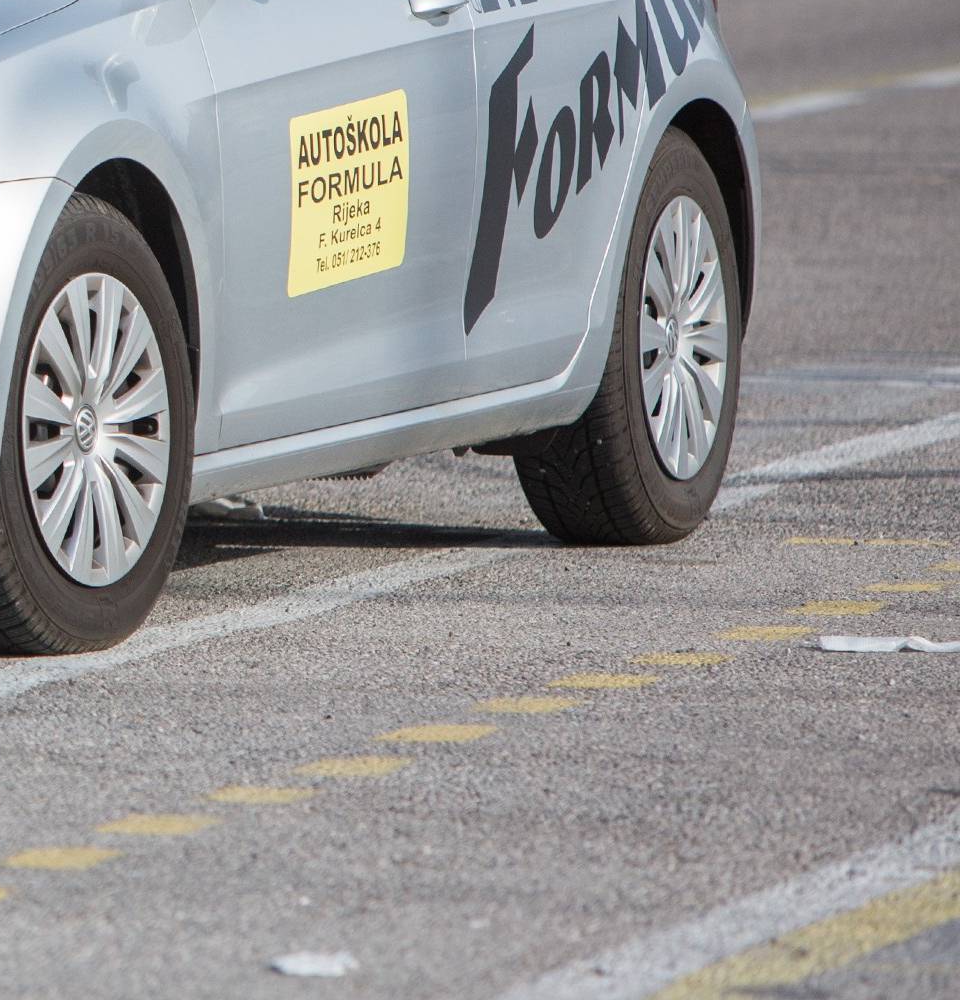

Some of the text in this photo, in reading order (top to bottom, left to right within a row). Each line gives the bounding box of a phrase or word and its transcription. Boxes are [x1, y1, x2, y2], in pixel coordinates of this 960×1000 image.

[298, 110, 403, 169] AUTOŠKOLA
[298, 156, 403, 208] FORMULA
[333, 198, 370, 226] Rijeka
[319, 232, 327, 249] F.
[375, 217, 382, 232] 4
[316, 256, 329, 273] Tel.
